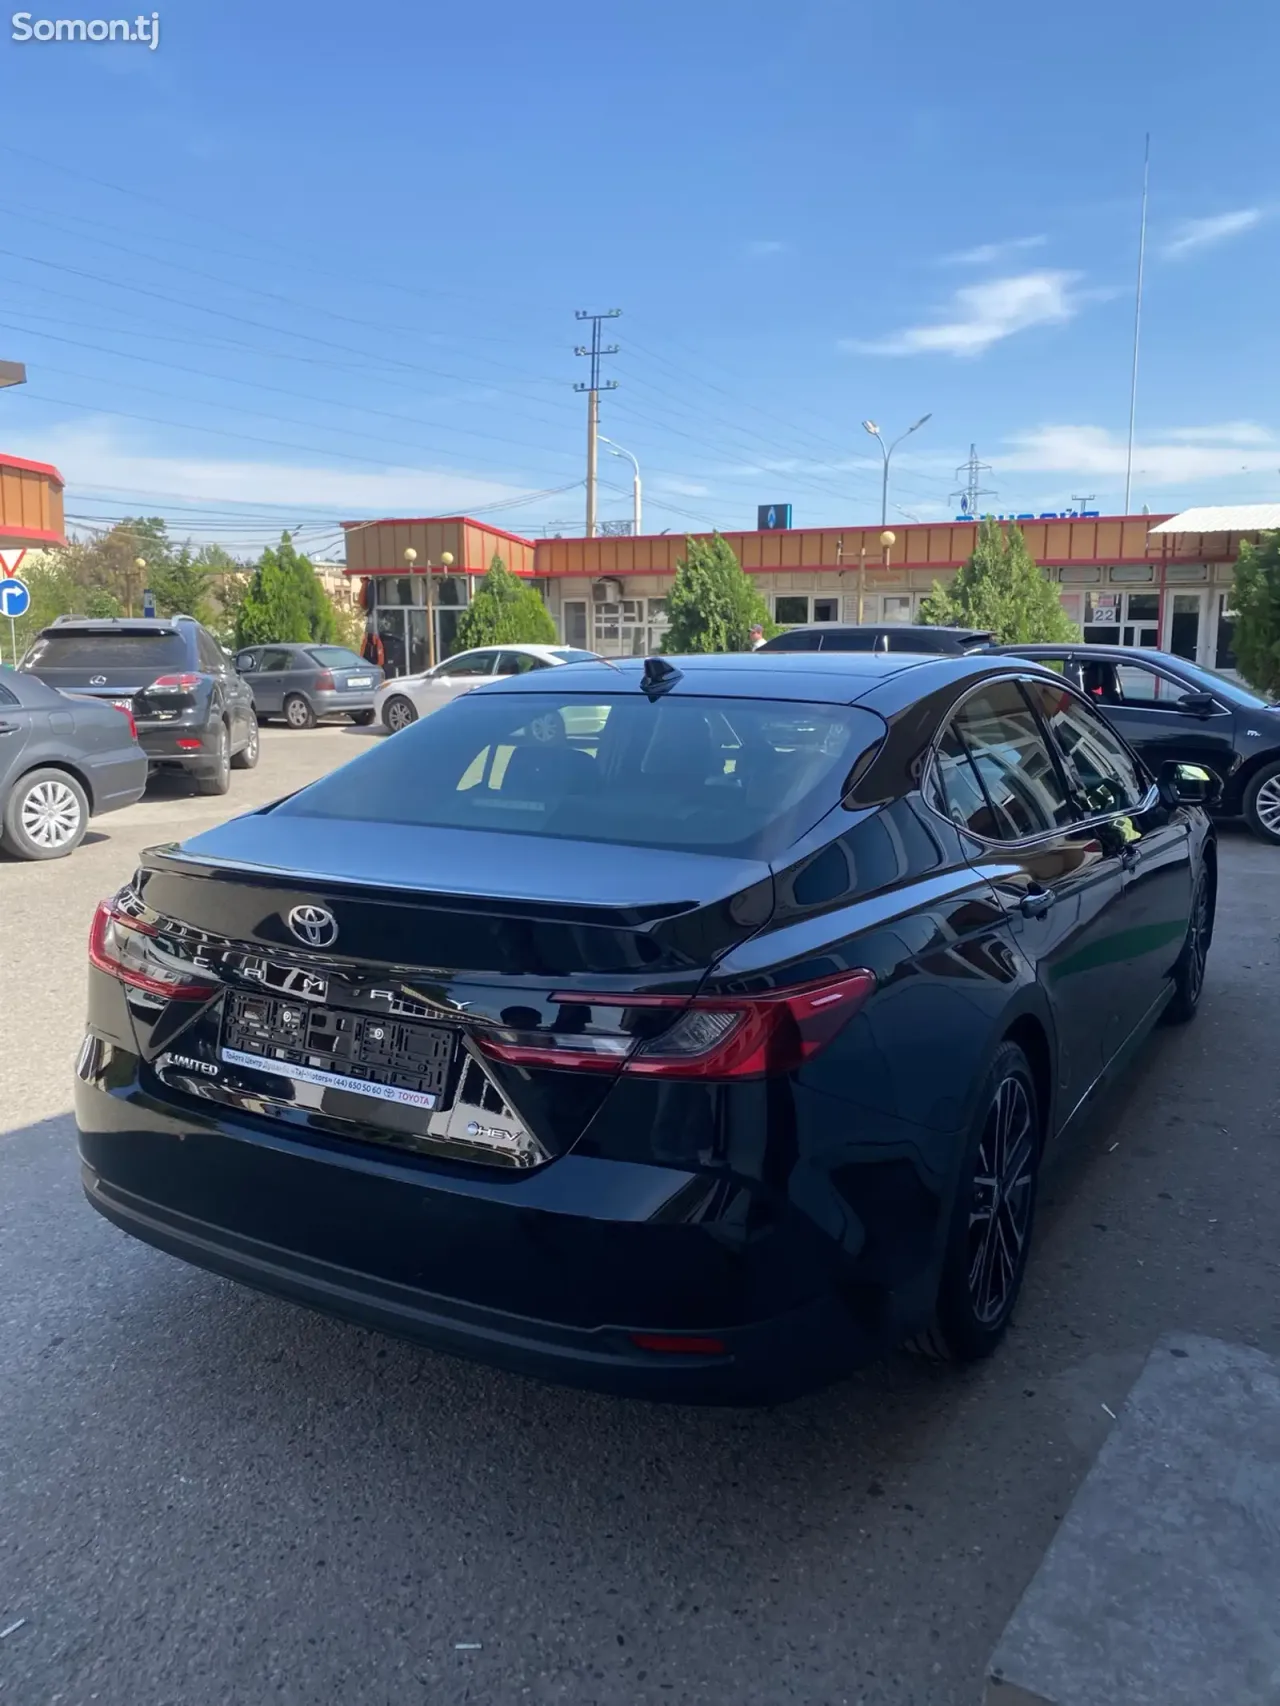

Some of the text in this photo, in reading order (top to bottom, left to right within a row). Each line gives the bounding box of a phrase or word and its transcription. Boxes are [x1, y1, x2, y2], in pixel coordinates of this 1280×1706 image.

[1094, 609, 1114, 621] 22
[167, 1053, 219, 1076] LIMITED
[333, 1077, 348, 1088] (44)
[348, 1080, 362, 1091] 650
[362, 1083, 372, 1092] 50
[371, 1085, 382, 1095] 60
[398, 1091, 430, 1106] TOYOTA
